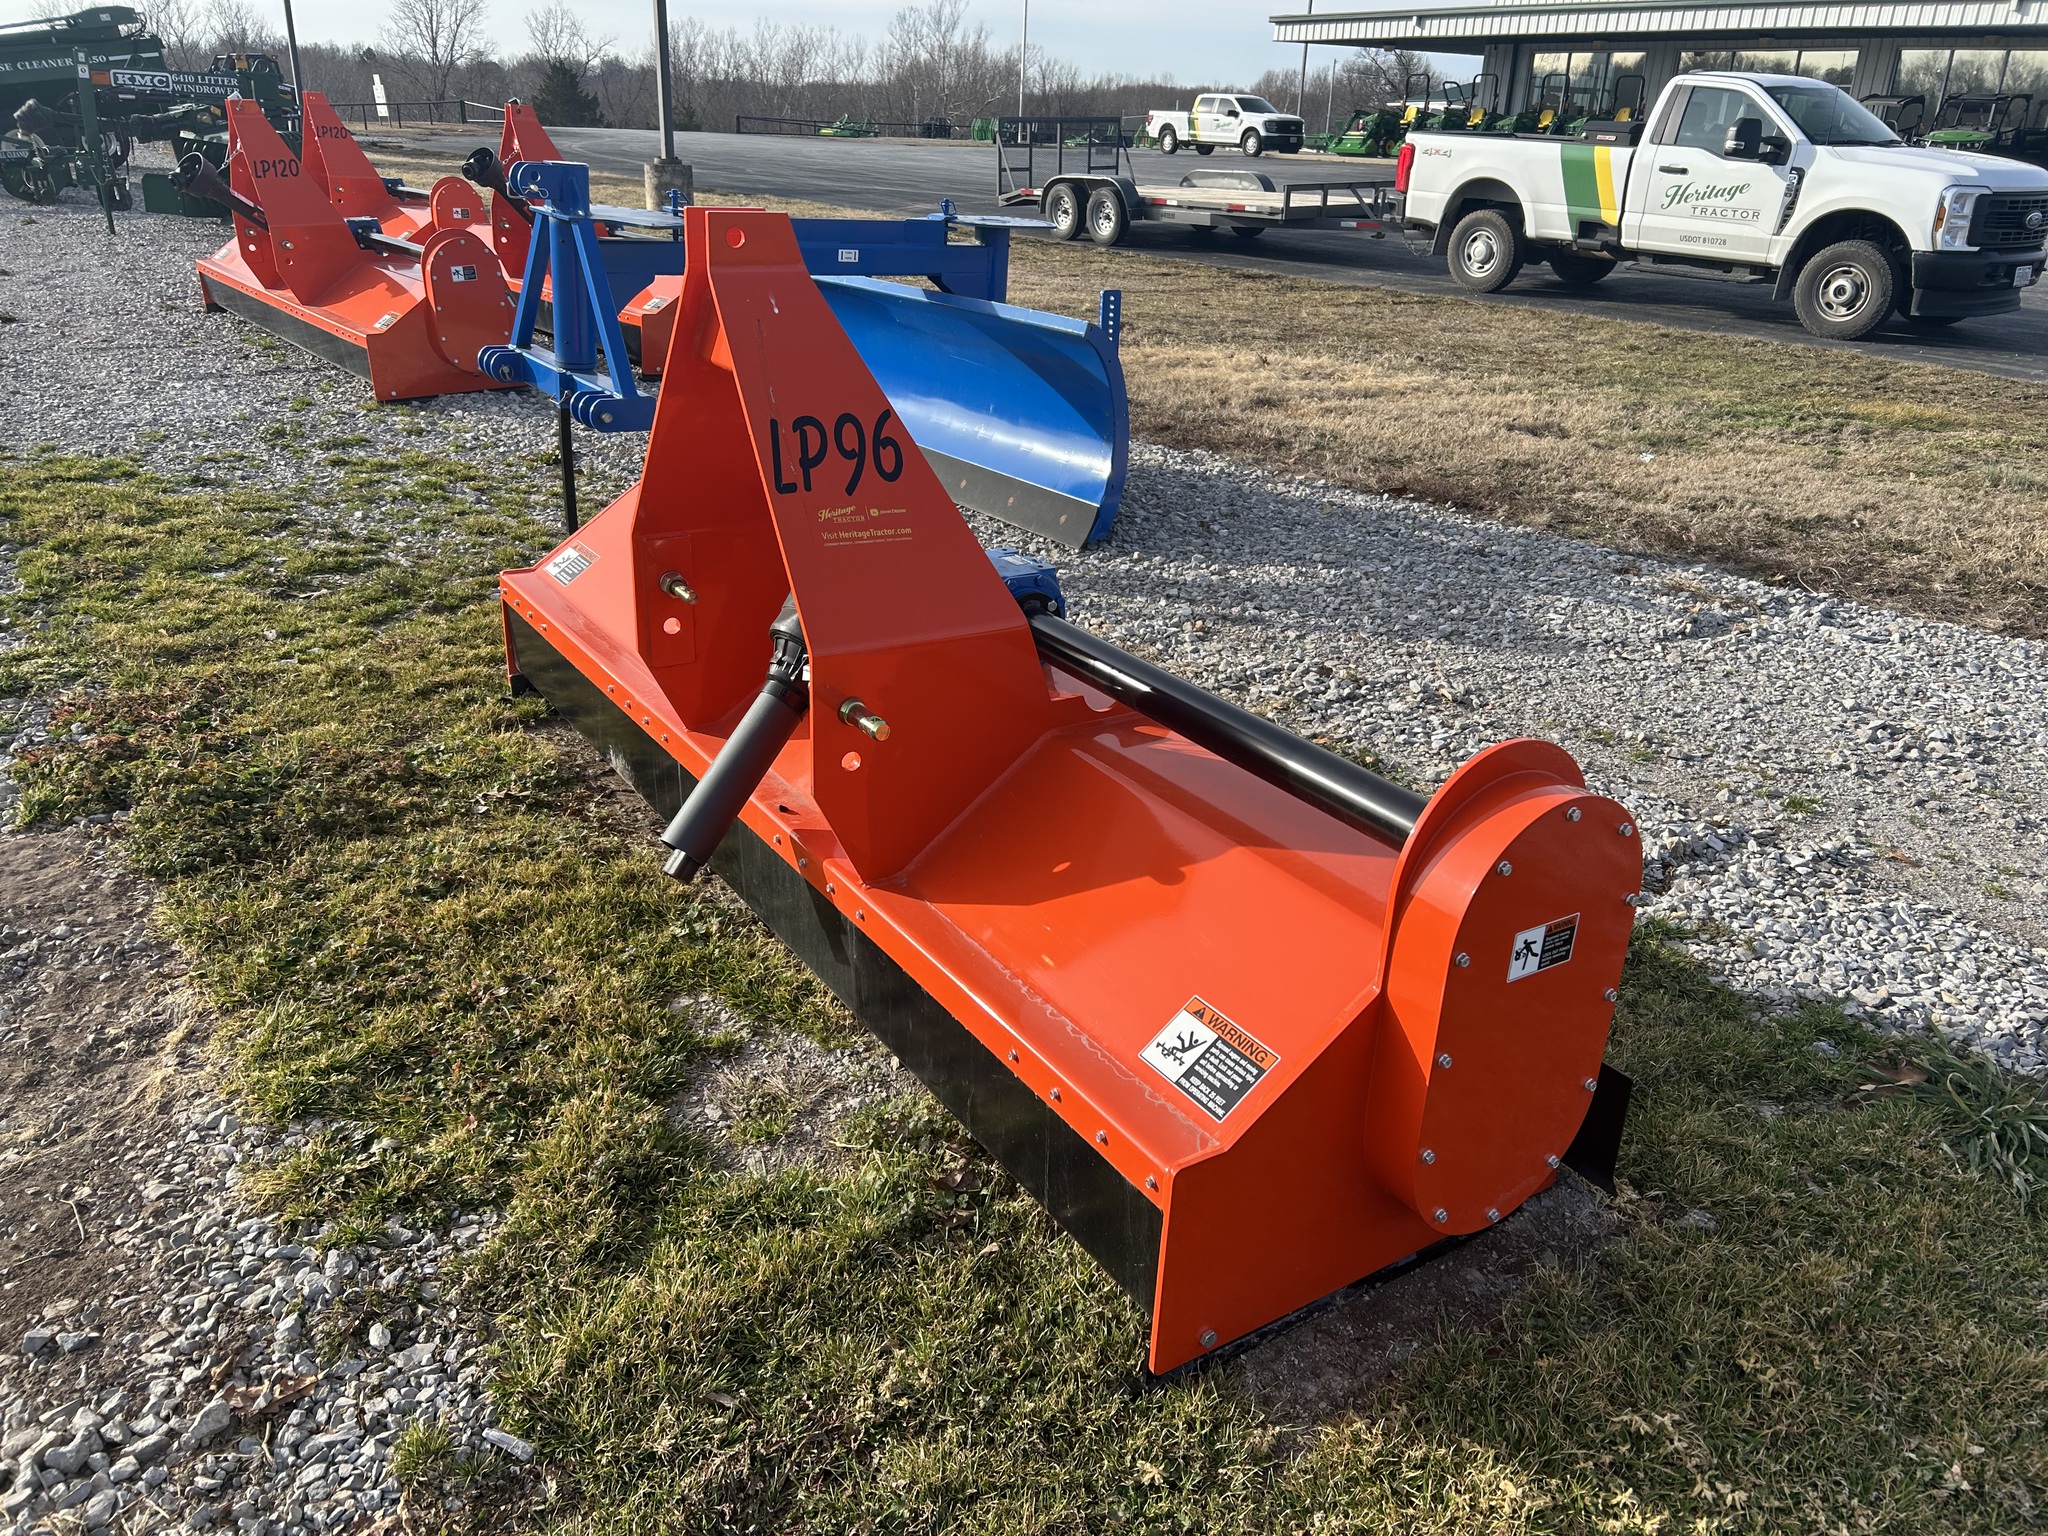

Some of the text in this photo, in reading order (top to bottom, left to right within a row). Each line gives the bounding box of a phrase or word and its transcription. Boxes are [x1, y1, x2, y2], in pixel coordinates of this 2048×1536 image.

[16, 58, 74, 70] CLEANER
[115, 74, 167, 87] KMC
[172, 74, 239, 86] 6410 LITTER
[316, 125, 348, 139] LP120
[253, 158, 300, 179] LP120
[1660, 182, 1751, 210] Heritage
[1691, 206, 1760, 220] TRACTOR
[1680, 235, 1726, 246] USDOT 810728
[770, 408, 904, 497] LP96
[818, 505, 856, 522] Heritage
[832, 516, 865, 524] TRACTOR
[821, 528, 912, 540] Visit HeritageTractor.com
[1208, 1014, 1268, 1064] WARNING
